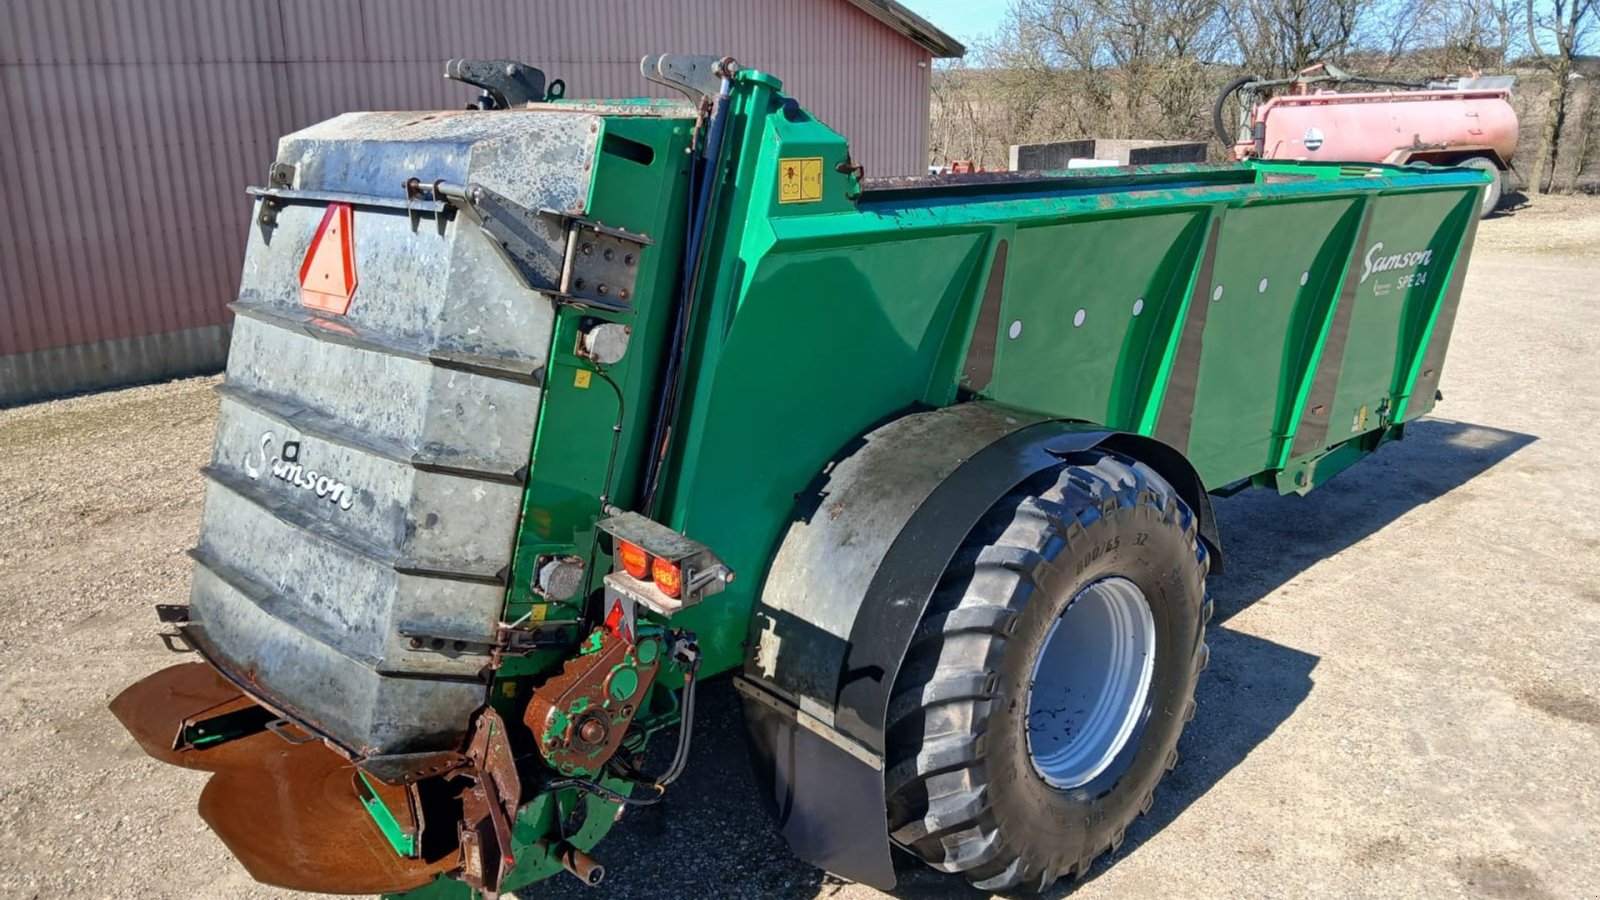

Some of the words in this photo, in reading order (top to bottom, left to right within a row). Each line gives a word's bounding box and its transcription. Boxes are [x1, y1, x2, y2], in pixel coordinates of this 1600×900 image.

[1360, 242, 1433, 284] Samson
[1397, 274, 1415, 290] SPE
[1415, 272, 1428, 287] 24
[244, 430, 354, 511] Samson
